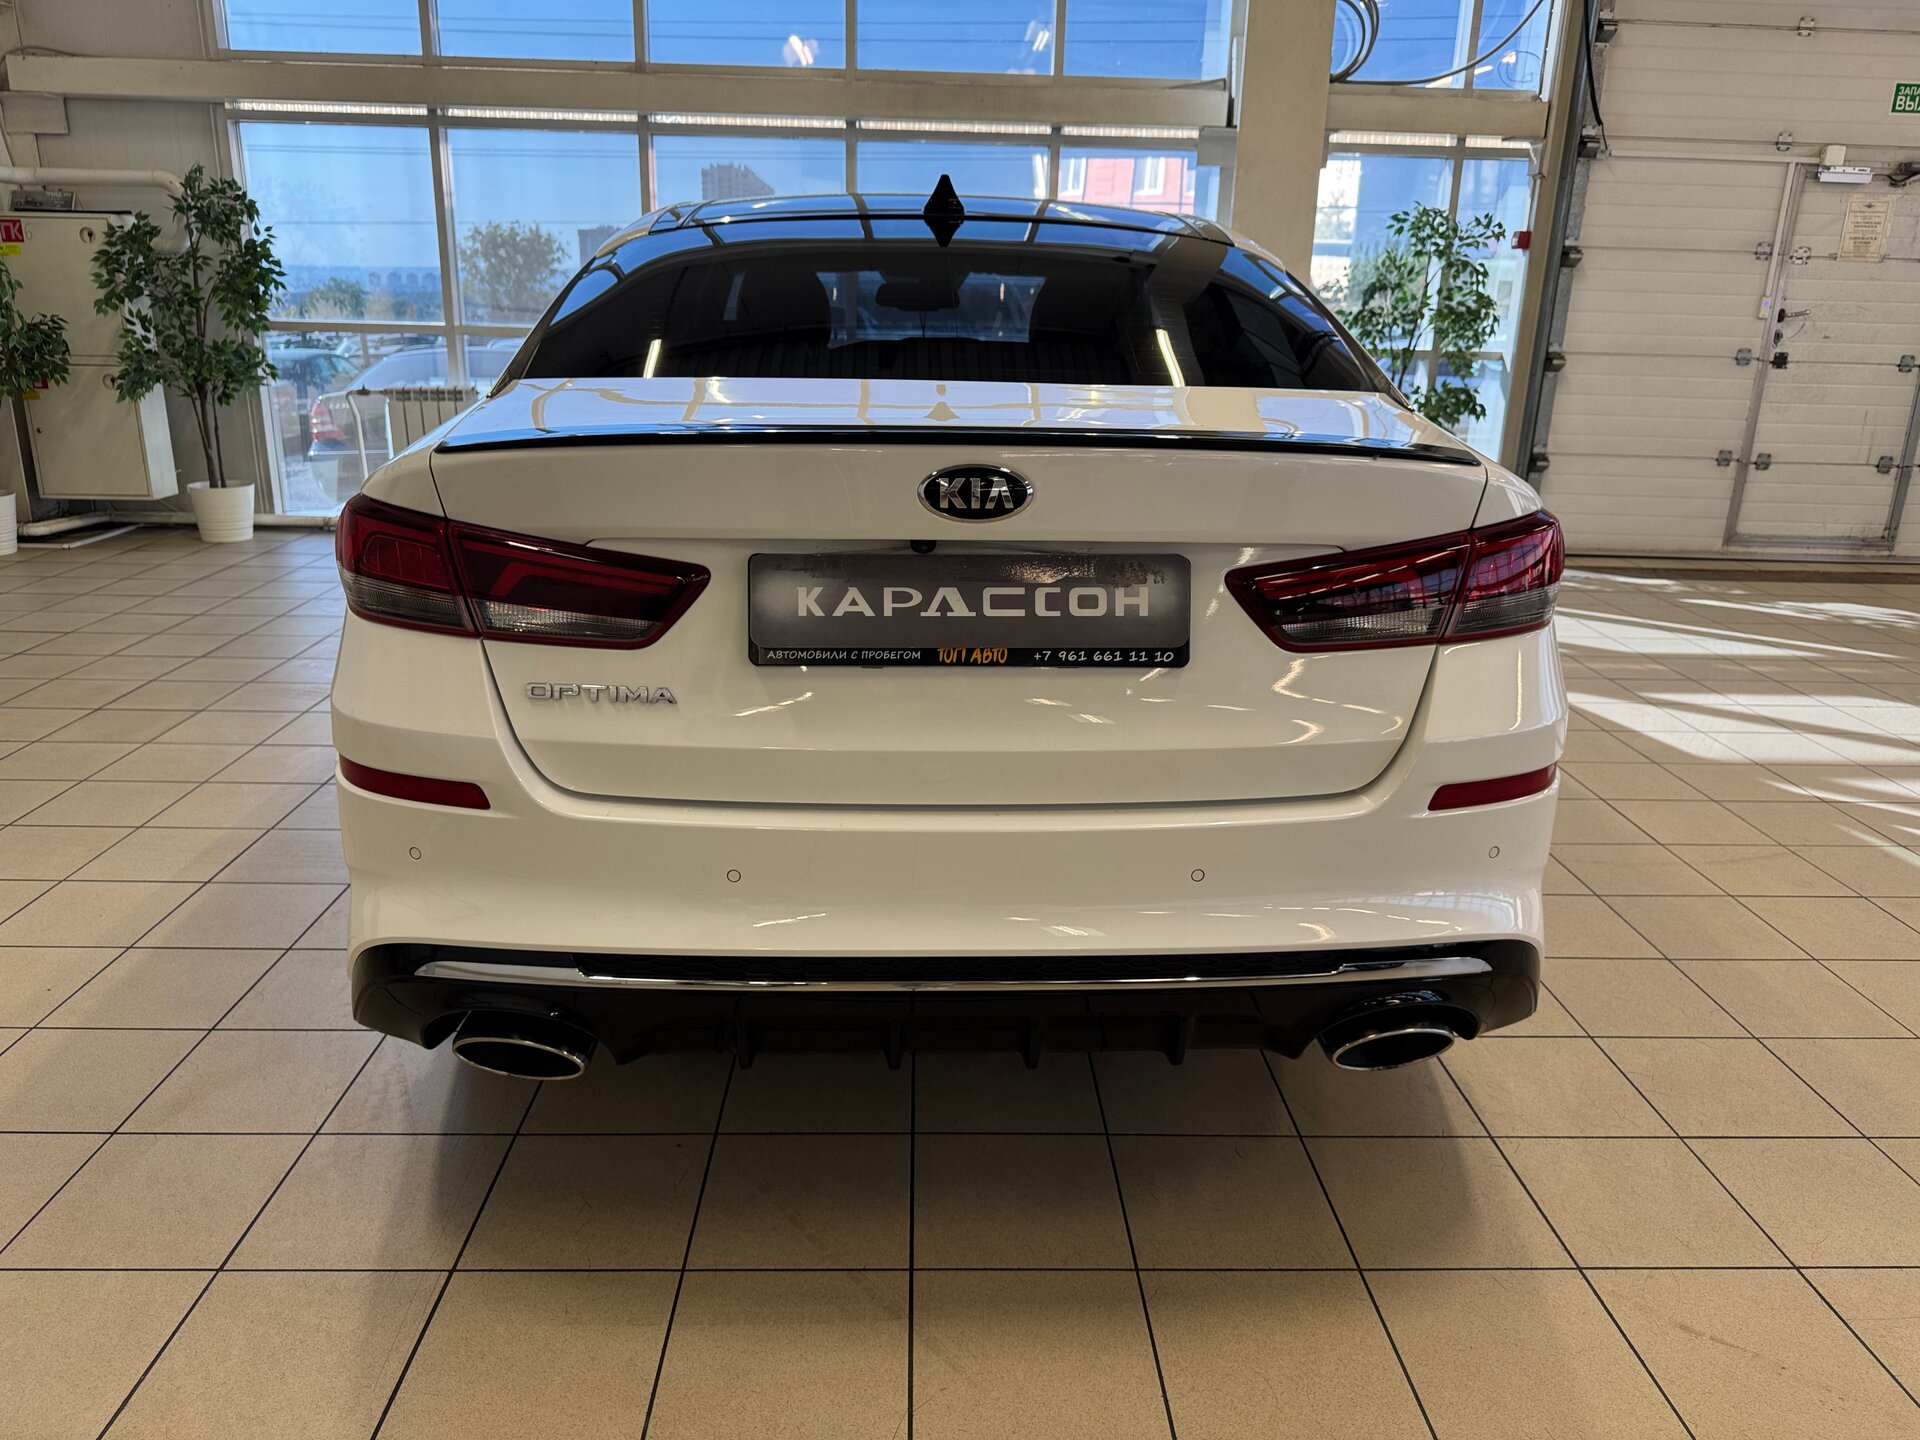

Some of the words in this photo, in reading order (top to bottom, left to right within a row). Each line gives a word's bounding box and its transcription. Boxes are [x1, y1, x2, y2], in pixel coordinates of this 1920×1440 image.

[1895, 95, 1920, 111] ВЫ
[938, 477, 1014, 509] KIA
[767, 650, 847, 660] АВТОМОБИЛИ
[850, 650, 858, 660] С
[861, 650, 921, 660] ПРОБЕГОМ
[937, 648, 966, 663] ТОП
[970, 648, 1008, 664] АВТО
[1034, 651, 1051, 661] +7
[1058, 651, 1087, 661] 961
[1093, 651, 1122, 662] 661
[1129, 651, 1148, 662] 11
[1154, 651, 1174, 662] 10
[526, 682, 678, 705] OPTIMA
